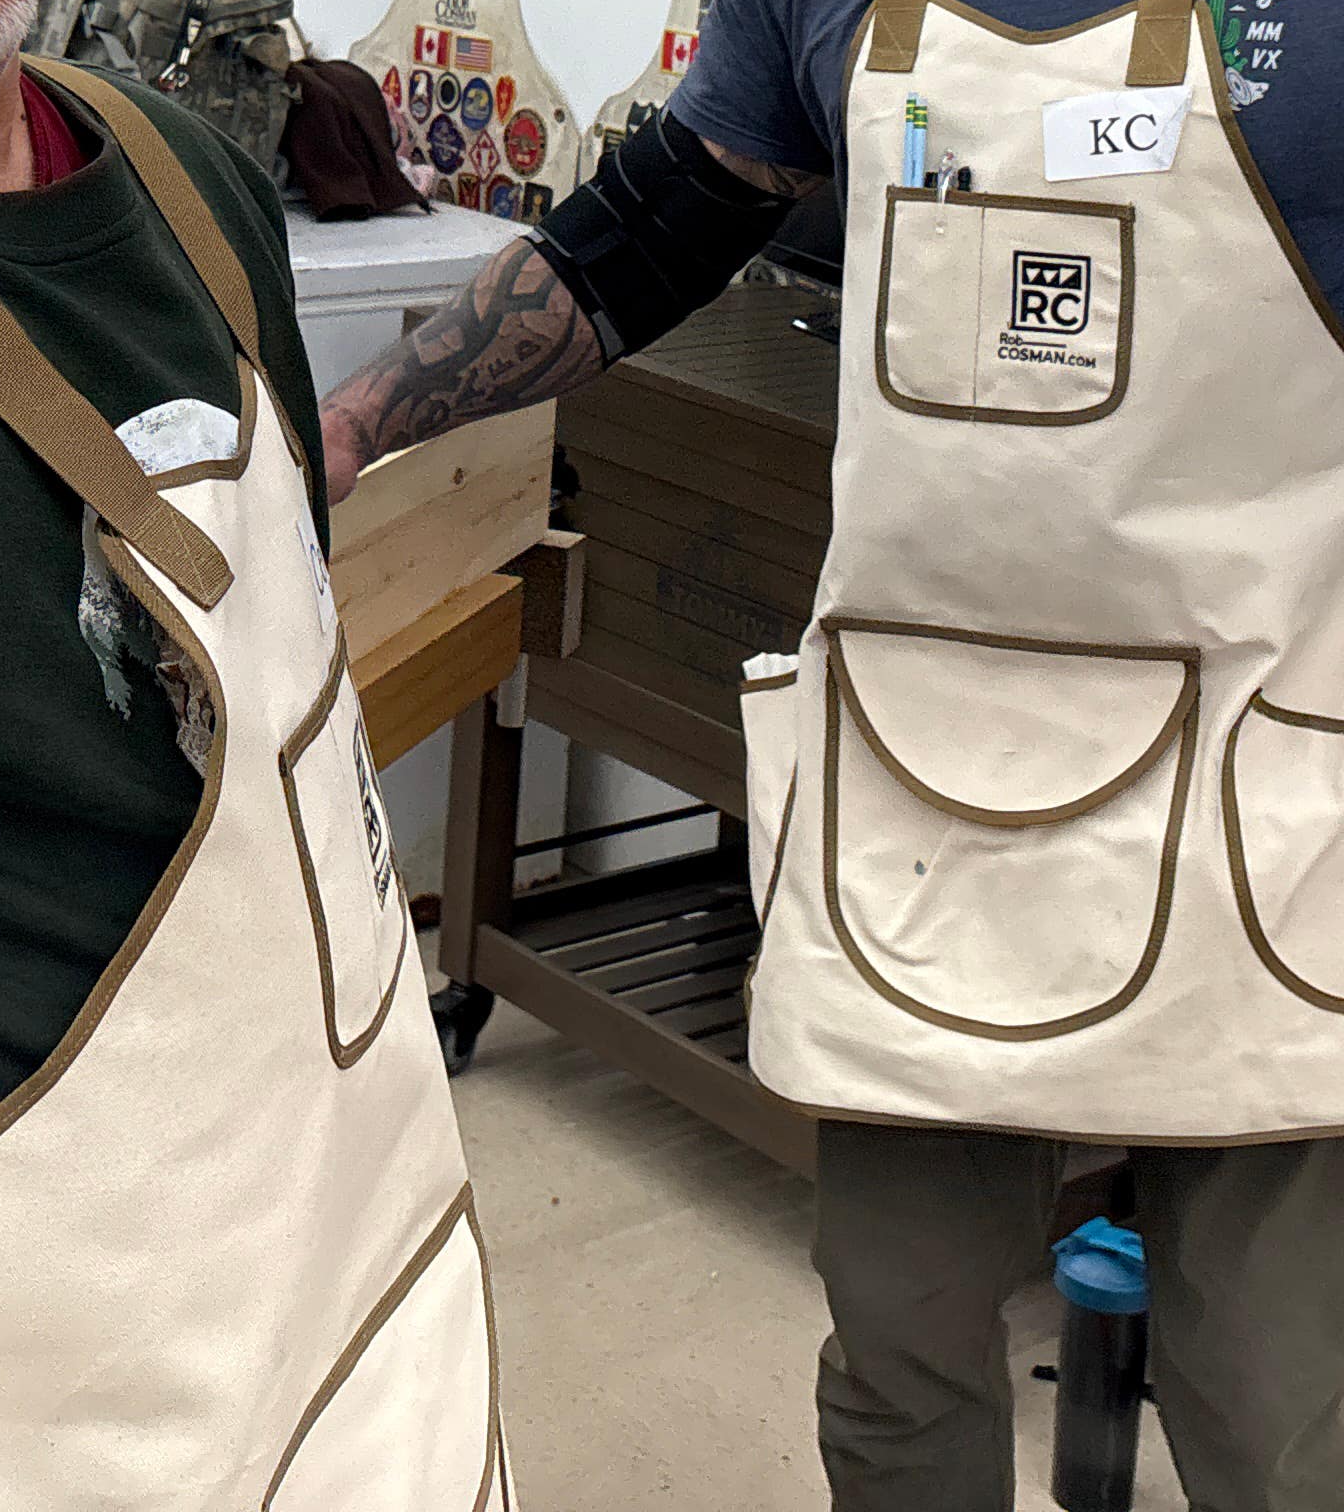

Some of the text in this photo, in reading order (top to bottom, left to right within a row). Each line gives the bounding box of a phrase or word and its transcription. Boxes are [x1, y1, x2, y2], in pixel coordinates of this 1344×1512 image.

[1244, 20, 1285, 42] MM
[1250, 48, 1284, 70] VX
[1088, 113, 1159, 156] KC
[1020, 288, 1081, 327] RC
[999, 332, 1024, 347] Rob
